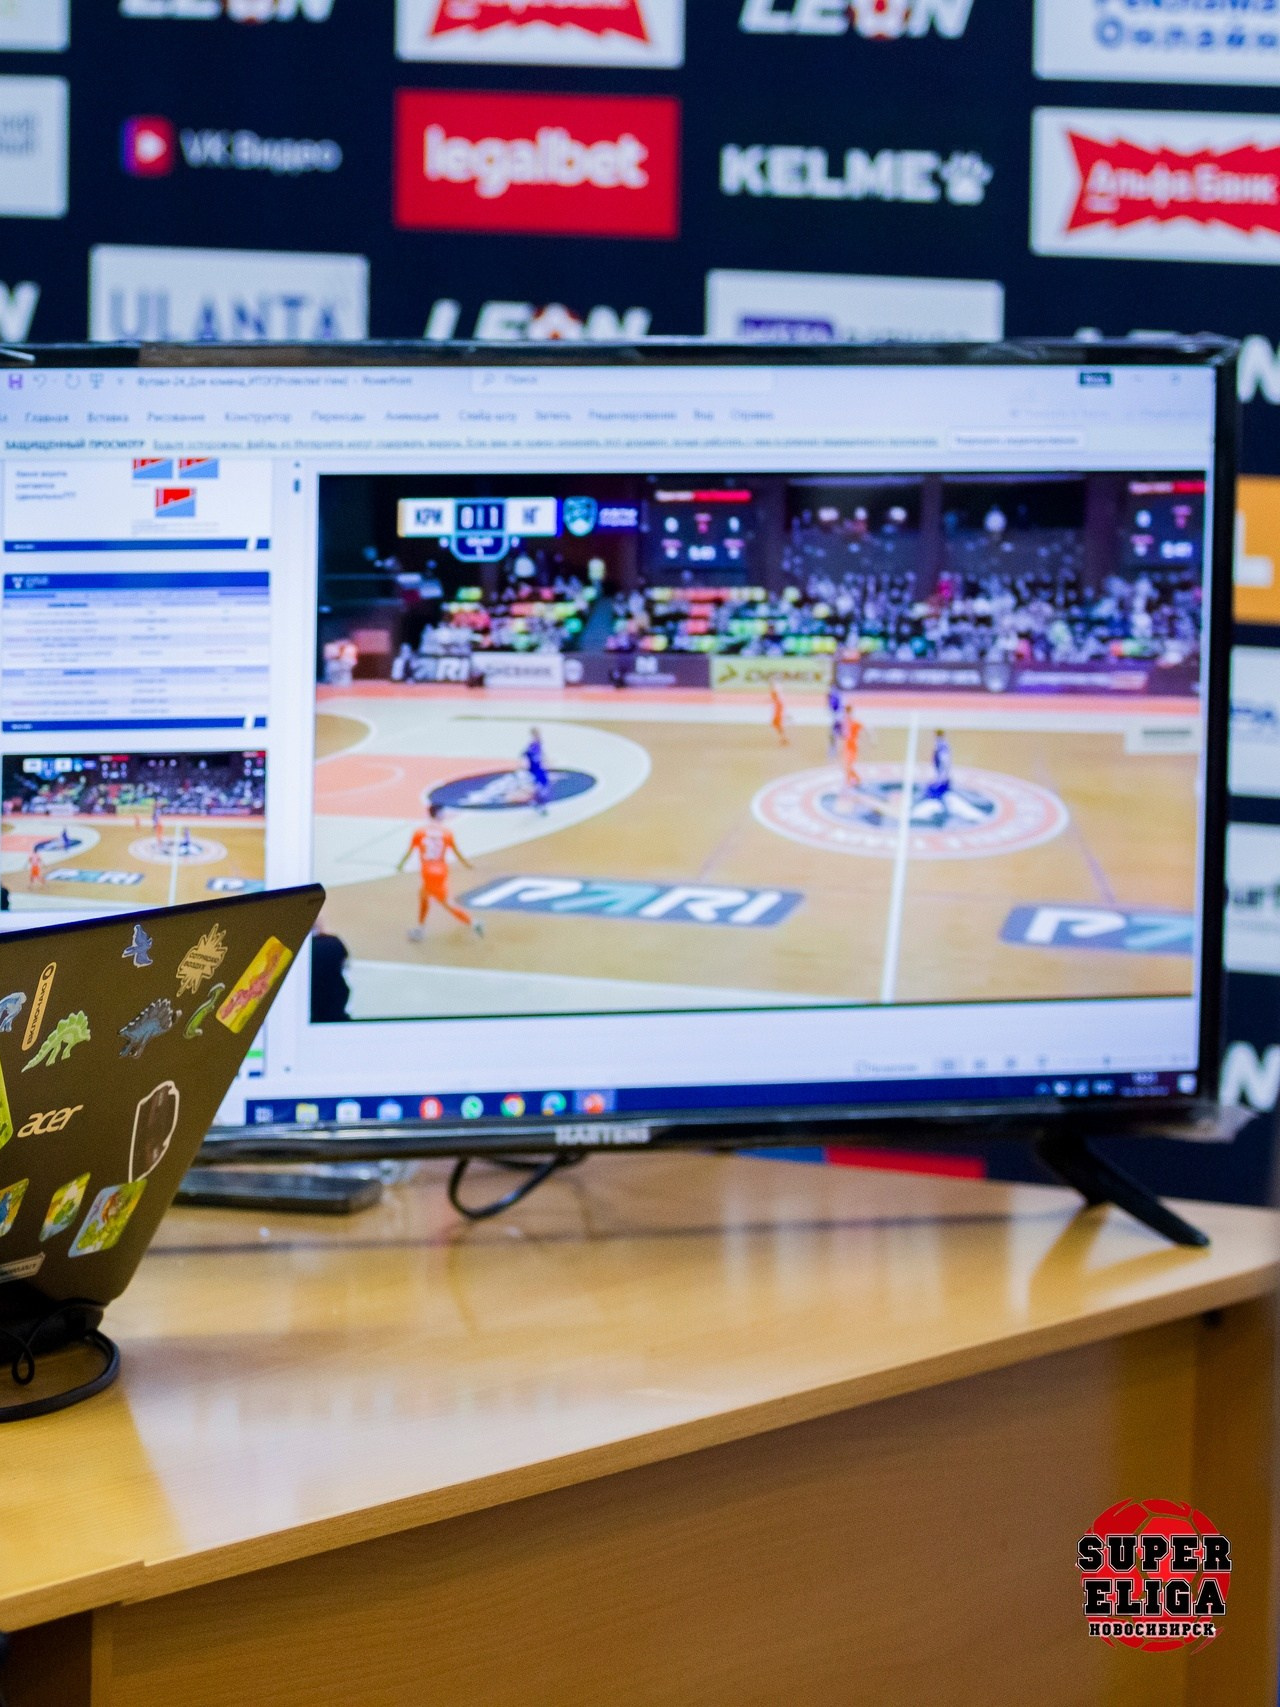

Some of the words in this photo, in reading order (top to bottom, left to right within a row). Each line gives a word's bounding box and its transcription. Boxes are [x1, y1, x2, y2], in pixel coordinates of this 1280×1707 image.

[181, 128, 229, 165] VK
[234, 130, 344, 175] Видео
[423, 123, 649, 199] legalbet
[720, 143, 942, 203] KELME
[472, 876, 783, 926] PARI
[26, 982, 48, 1045] ВКЛЮЧАЮ
[17, 1104, 84, 1138] acer
